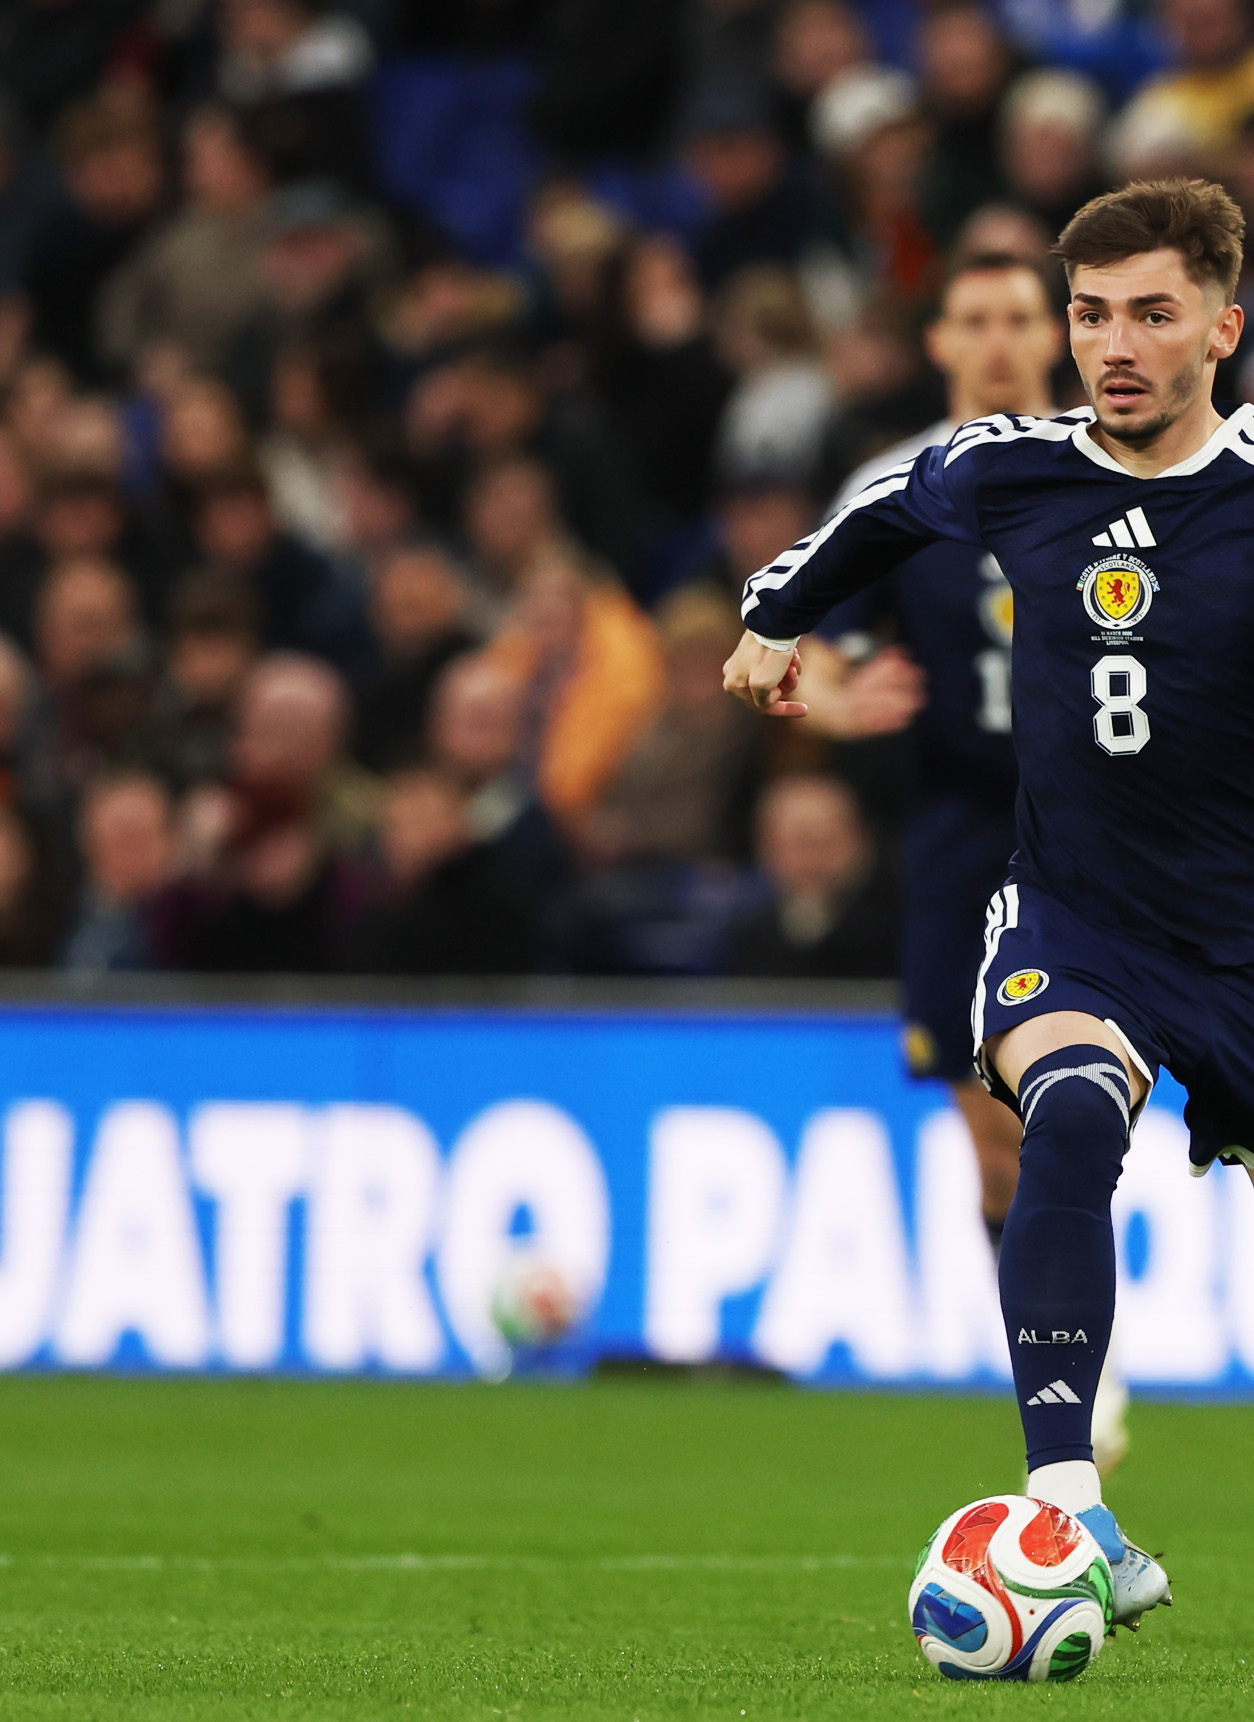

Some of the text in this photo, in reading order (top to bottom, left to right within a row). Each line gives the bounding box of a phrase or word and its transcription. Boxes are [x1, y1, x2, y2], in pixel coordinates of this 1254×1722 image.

[1101, 562, 1135, 570] SCOTLAND
[1128, 555, 1158, 582] SCOTLAND
[1090, 655, 1151, 757] 8
[1018, 1327, 1088, 1344] ALBA
